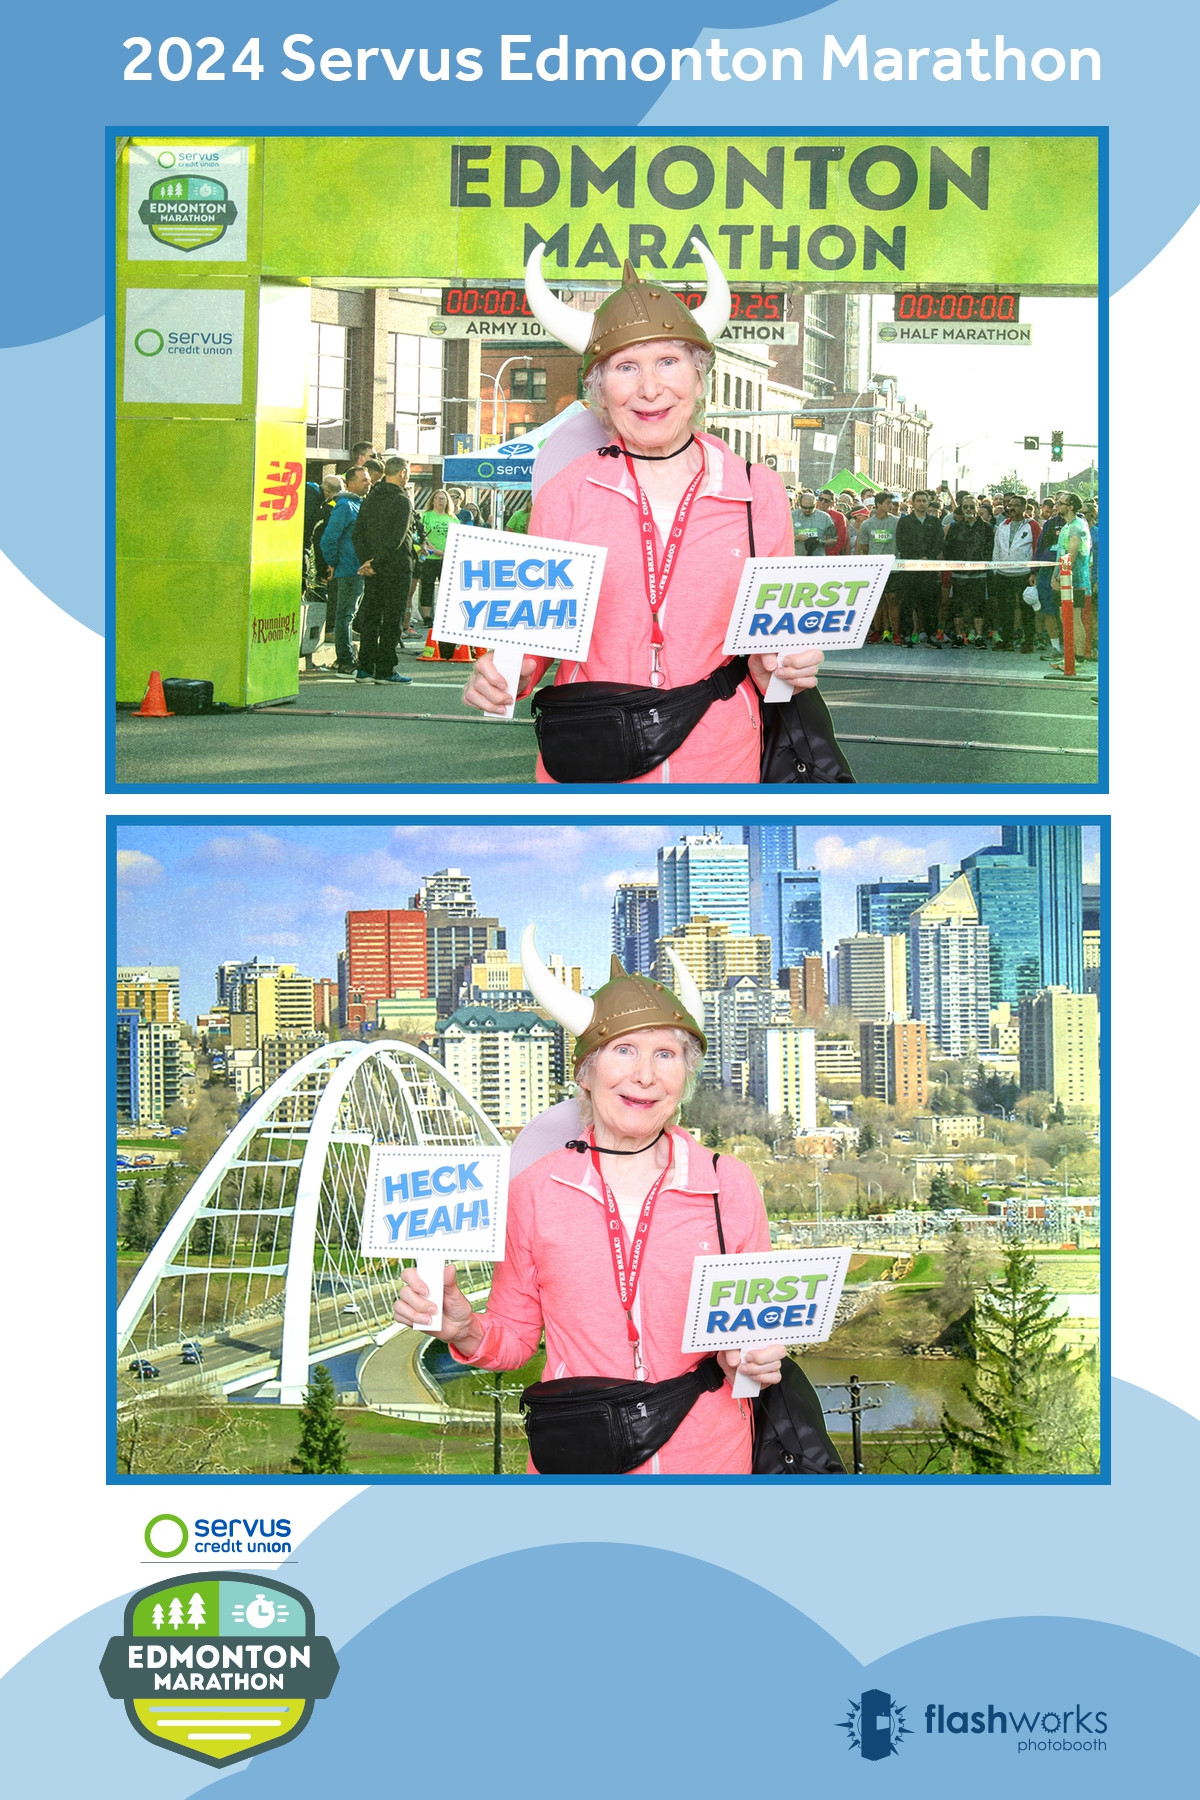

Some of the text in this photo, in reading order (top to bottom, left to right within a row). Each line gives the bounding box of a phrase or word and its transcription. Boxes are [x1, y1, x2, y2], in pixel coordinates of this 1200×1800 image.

[178, 152, 219, 161] servus
[450, 144, 991, 211] EDMONTON
[149, 202, 227, 214] EDMONTON
[160, 214, 216, 222] MARATHON
[523, 222, 907, 272] MARATHON
[168, 331, 233, 345] servus
[466, 321, 518, 336] ARMY
[719, 326, 785, 340] ATHON
[900, 327, 939, 340] HALF
[942, 328, 1031, 341] MARATHON
[168, 345, 233, 355] credit union
[496, 465, 533, 475] serv
[646, 539, 657, 605] COFFEE BREAK!!
[664, 543, 676, 575] COFFEE
[460, 559, 574, 591] HECK
[755, 581, 870, 609] FIRST
[257, 614, 290, 638] Running
[459, 599, 577, 631] YEAH!
[749, 610, 856, 636] RACE!
[382, 1161, 484, 1206] HECK
[383, 1199, 490, 1244] YEAH!
[613, 1237, 627, 1302] COFFEE BREAK!!
[632, 1239, 642, 1271] COFFEE
[709, 1274, 828, 1307] FIRST
[706, 1303, 817, 1333] RACE!
